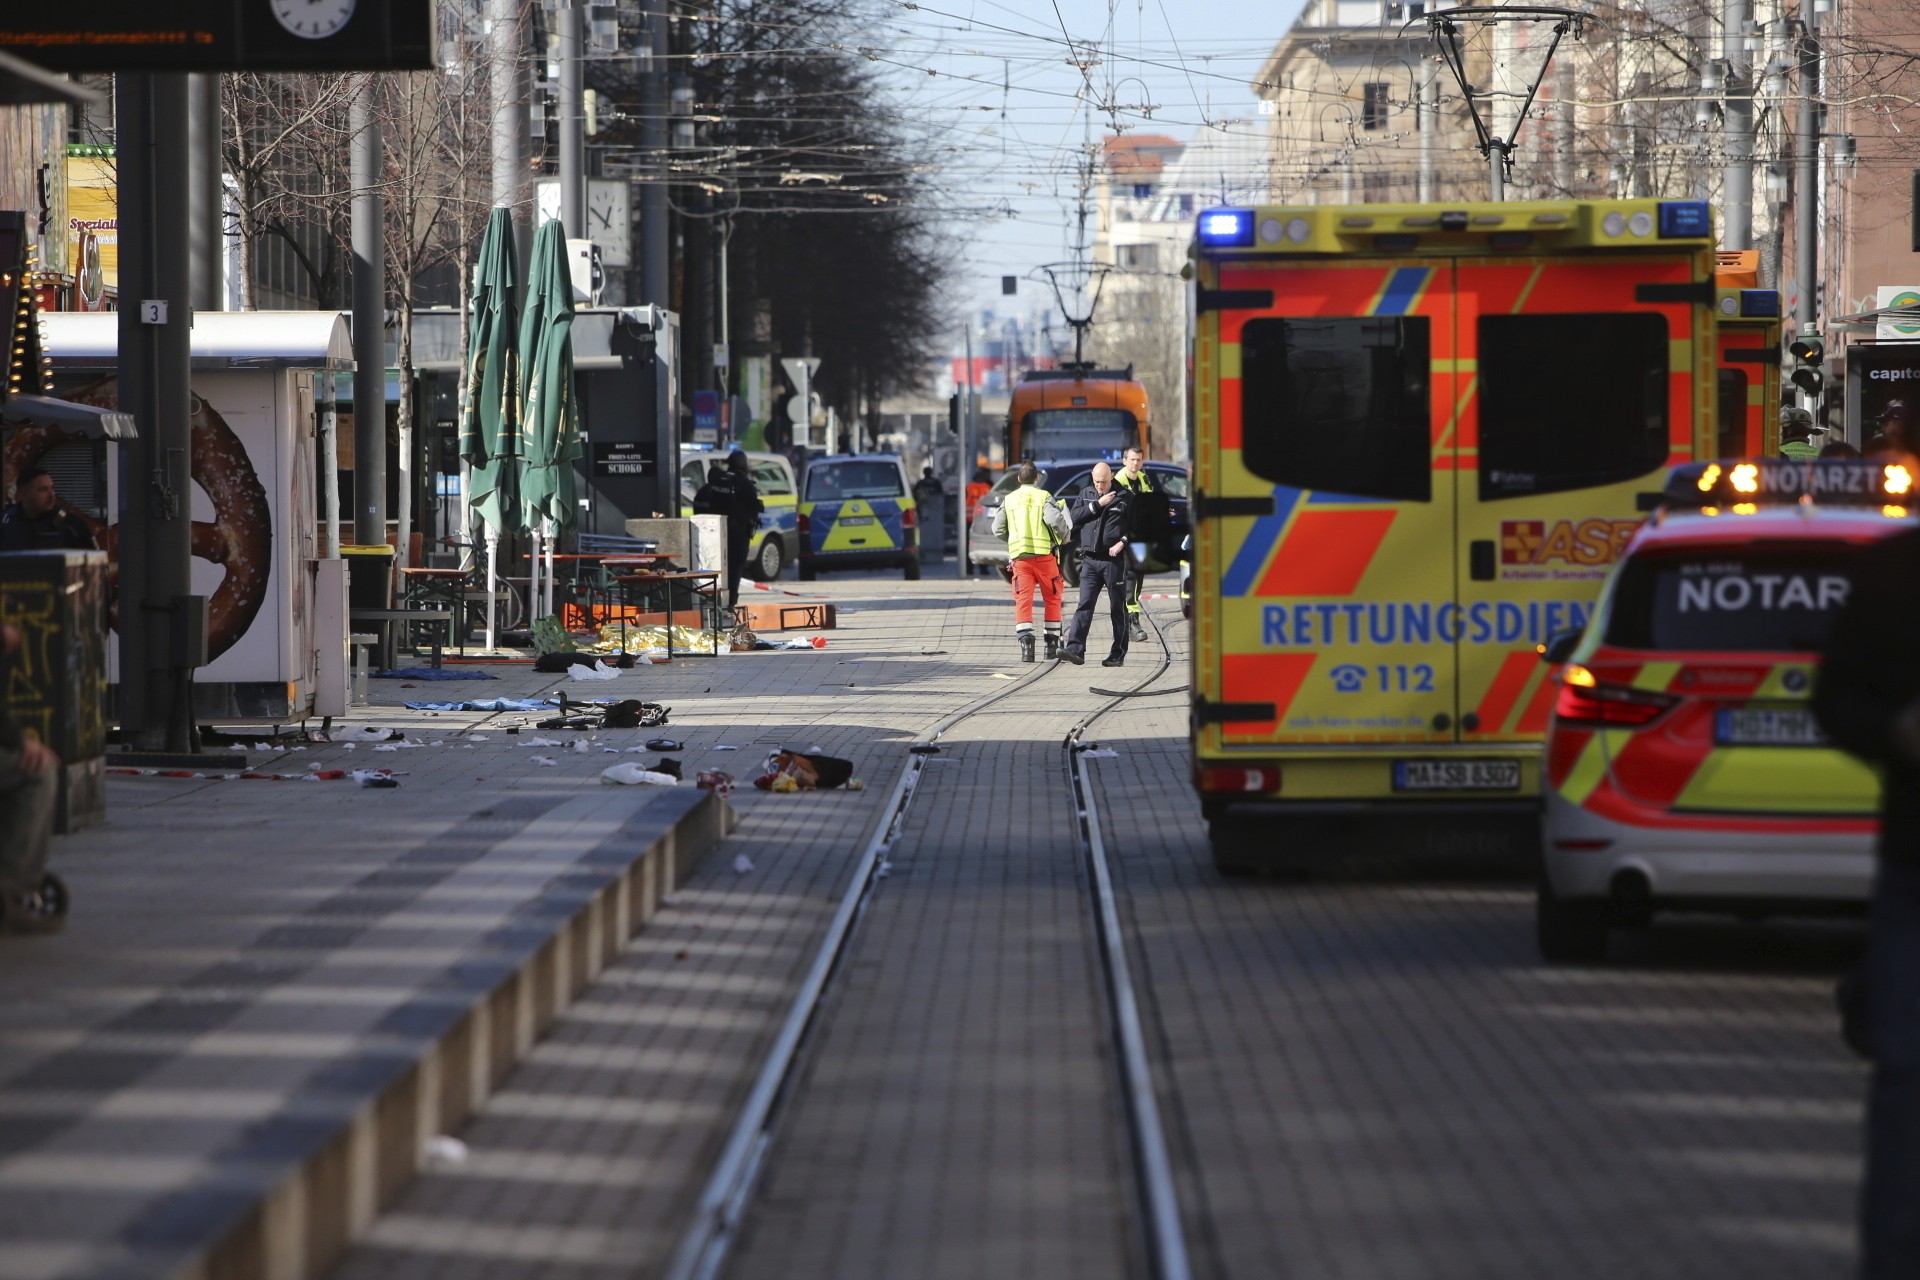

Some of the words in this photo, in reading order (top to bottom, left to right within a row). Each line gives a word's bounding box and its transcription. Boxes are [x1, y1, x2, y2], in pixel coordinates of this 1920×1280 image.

[150, 304, 159, 322] 3
[608, 463, 642, 474] SCHOKO
[1761, 466, 1879, 493] NOTARZT
[1375, 663, 1435, 693] 112
